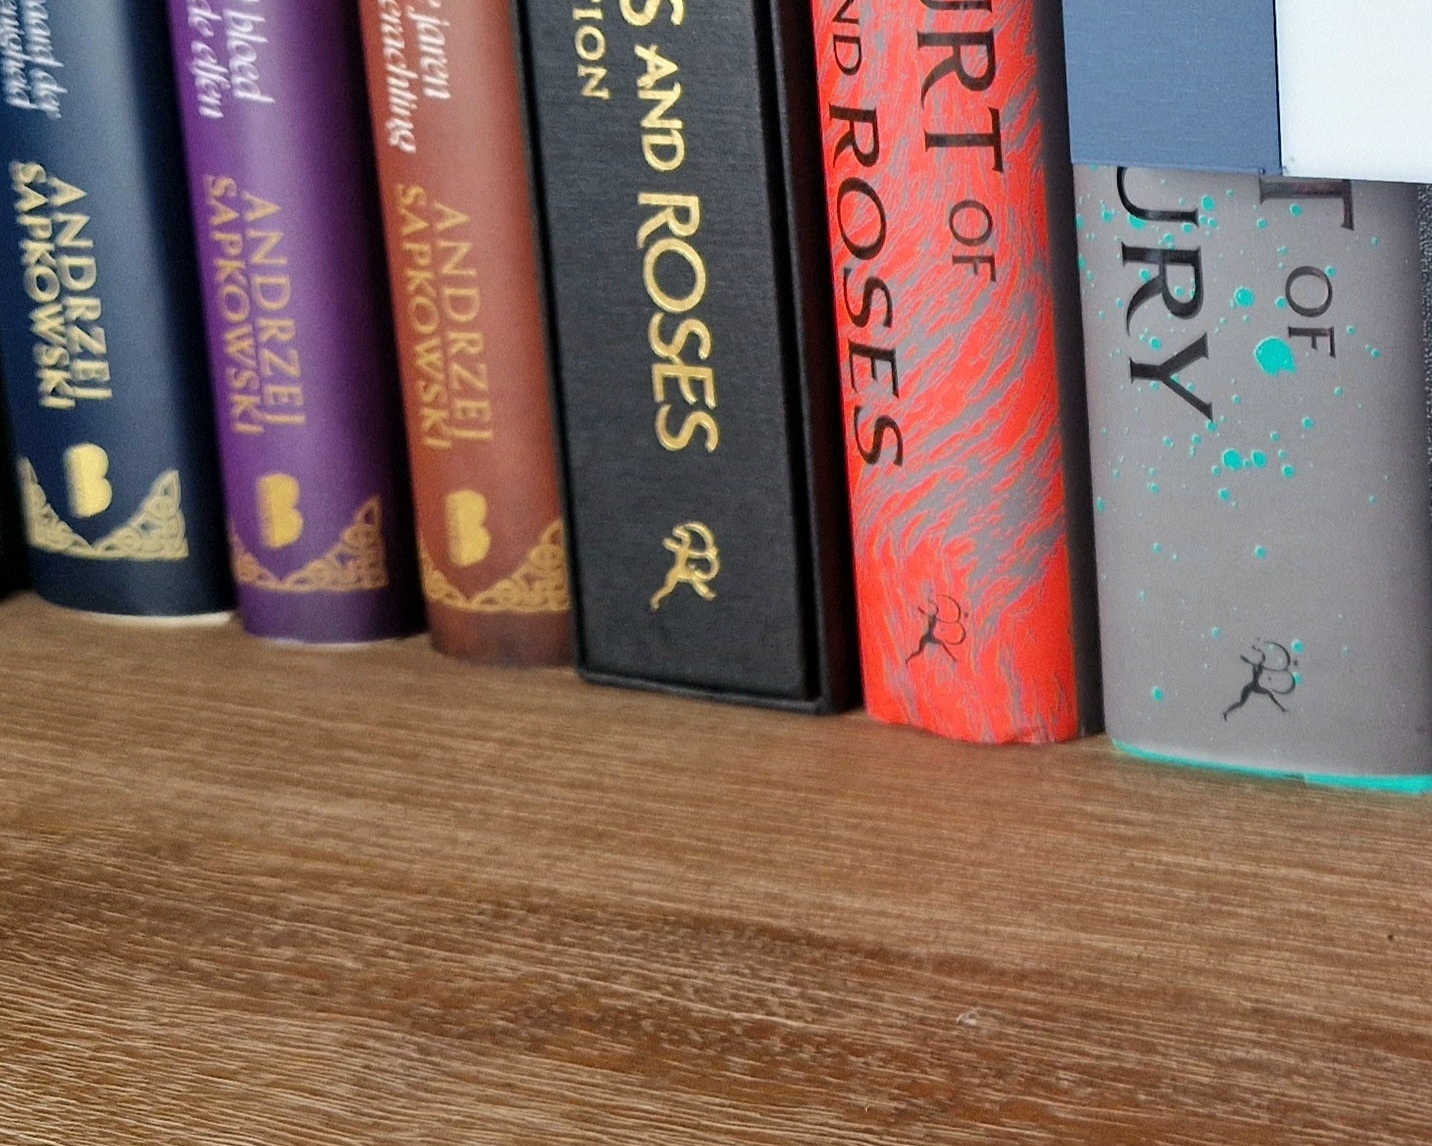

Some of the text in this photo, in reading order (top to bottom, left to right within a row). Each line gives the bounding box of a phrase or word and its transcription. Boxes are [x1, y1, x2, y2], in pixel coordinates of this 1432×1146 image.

[185, 41, 232, 120] elfen
[222, 8, 276, 105] bloed
[406, 5, 452, 100] jaren
[633, 42, 687, 172] AND
[10, 162, 74, 408] SAPKOWSKI
[47, 176, 112, 400] ANDRZEJ
[203, 175, 265, 435] SAPKOWSKI
[240, 189, 305, 425] ANDRZEJ
[398, 185, 450, 448] SAPKOWSKI
[431, 205, 493, 442] ANDRZEJ
[636, 191, 720, 452] ROSES
[827, 102, 903, 467] ROSES
[947, 198, 998, 283] OF
[1116, 166, 1213, 422] URY
[1285, 266, 1336, 358] OF
